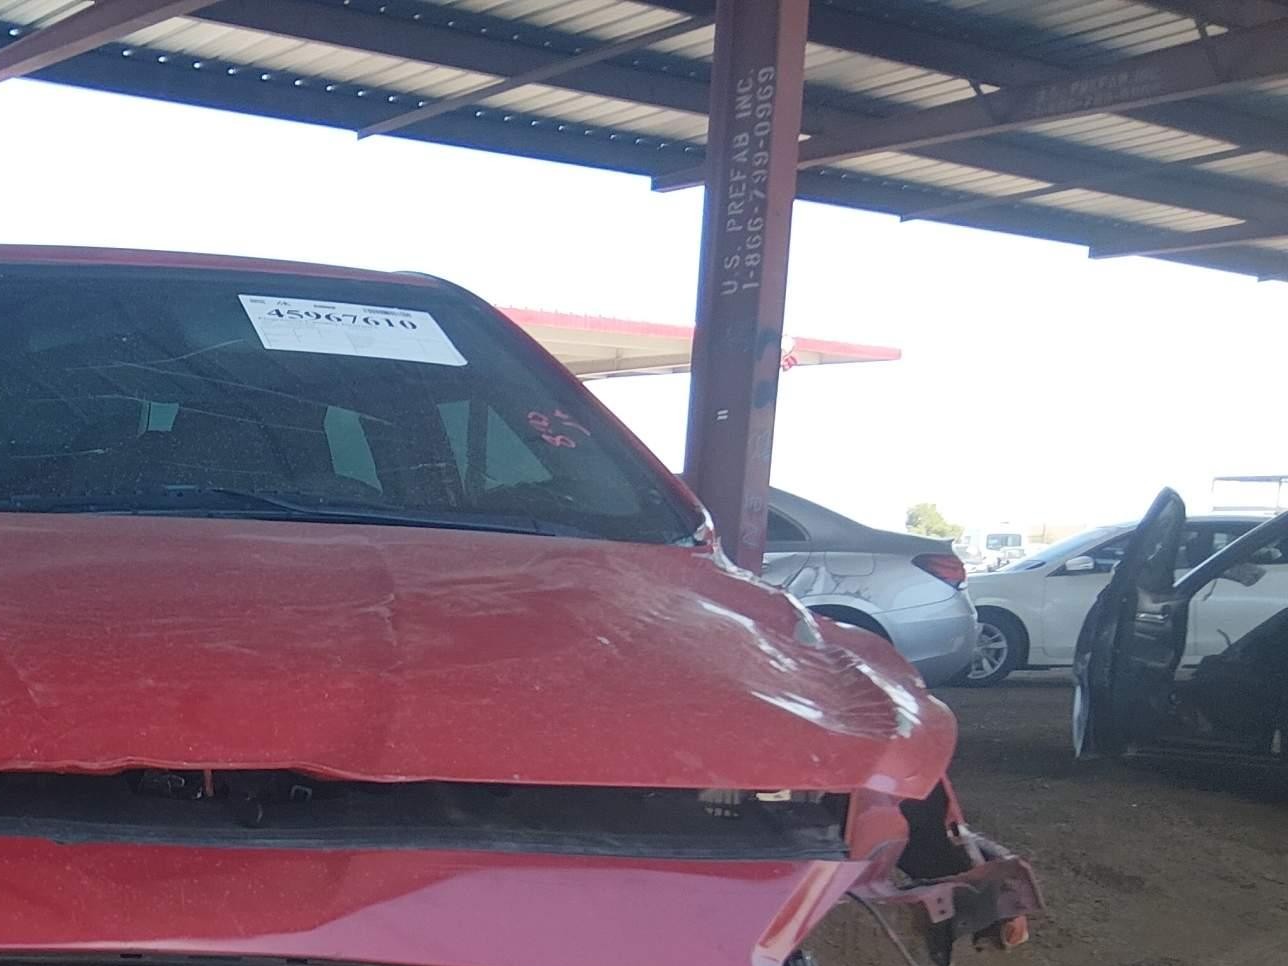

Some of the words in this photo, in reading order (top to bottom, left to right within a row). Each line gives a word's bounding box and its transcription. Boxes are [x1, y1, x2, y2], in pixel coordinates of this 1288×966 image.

[735, 68, 754, 120] INC.
[726, 131, 751, 233] PREFAB
[743, 65, 776, 291] 1-866-799-0969
[266, 308, 418, 331] 45967610
